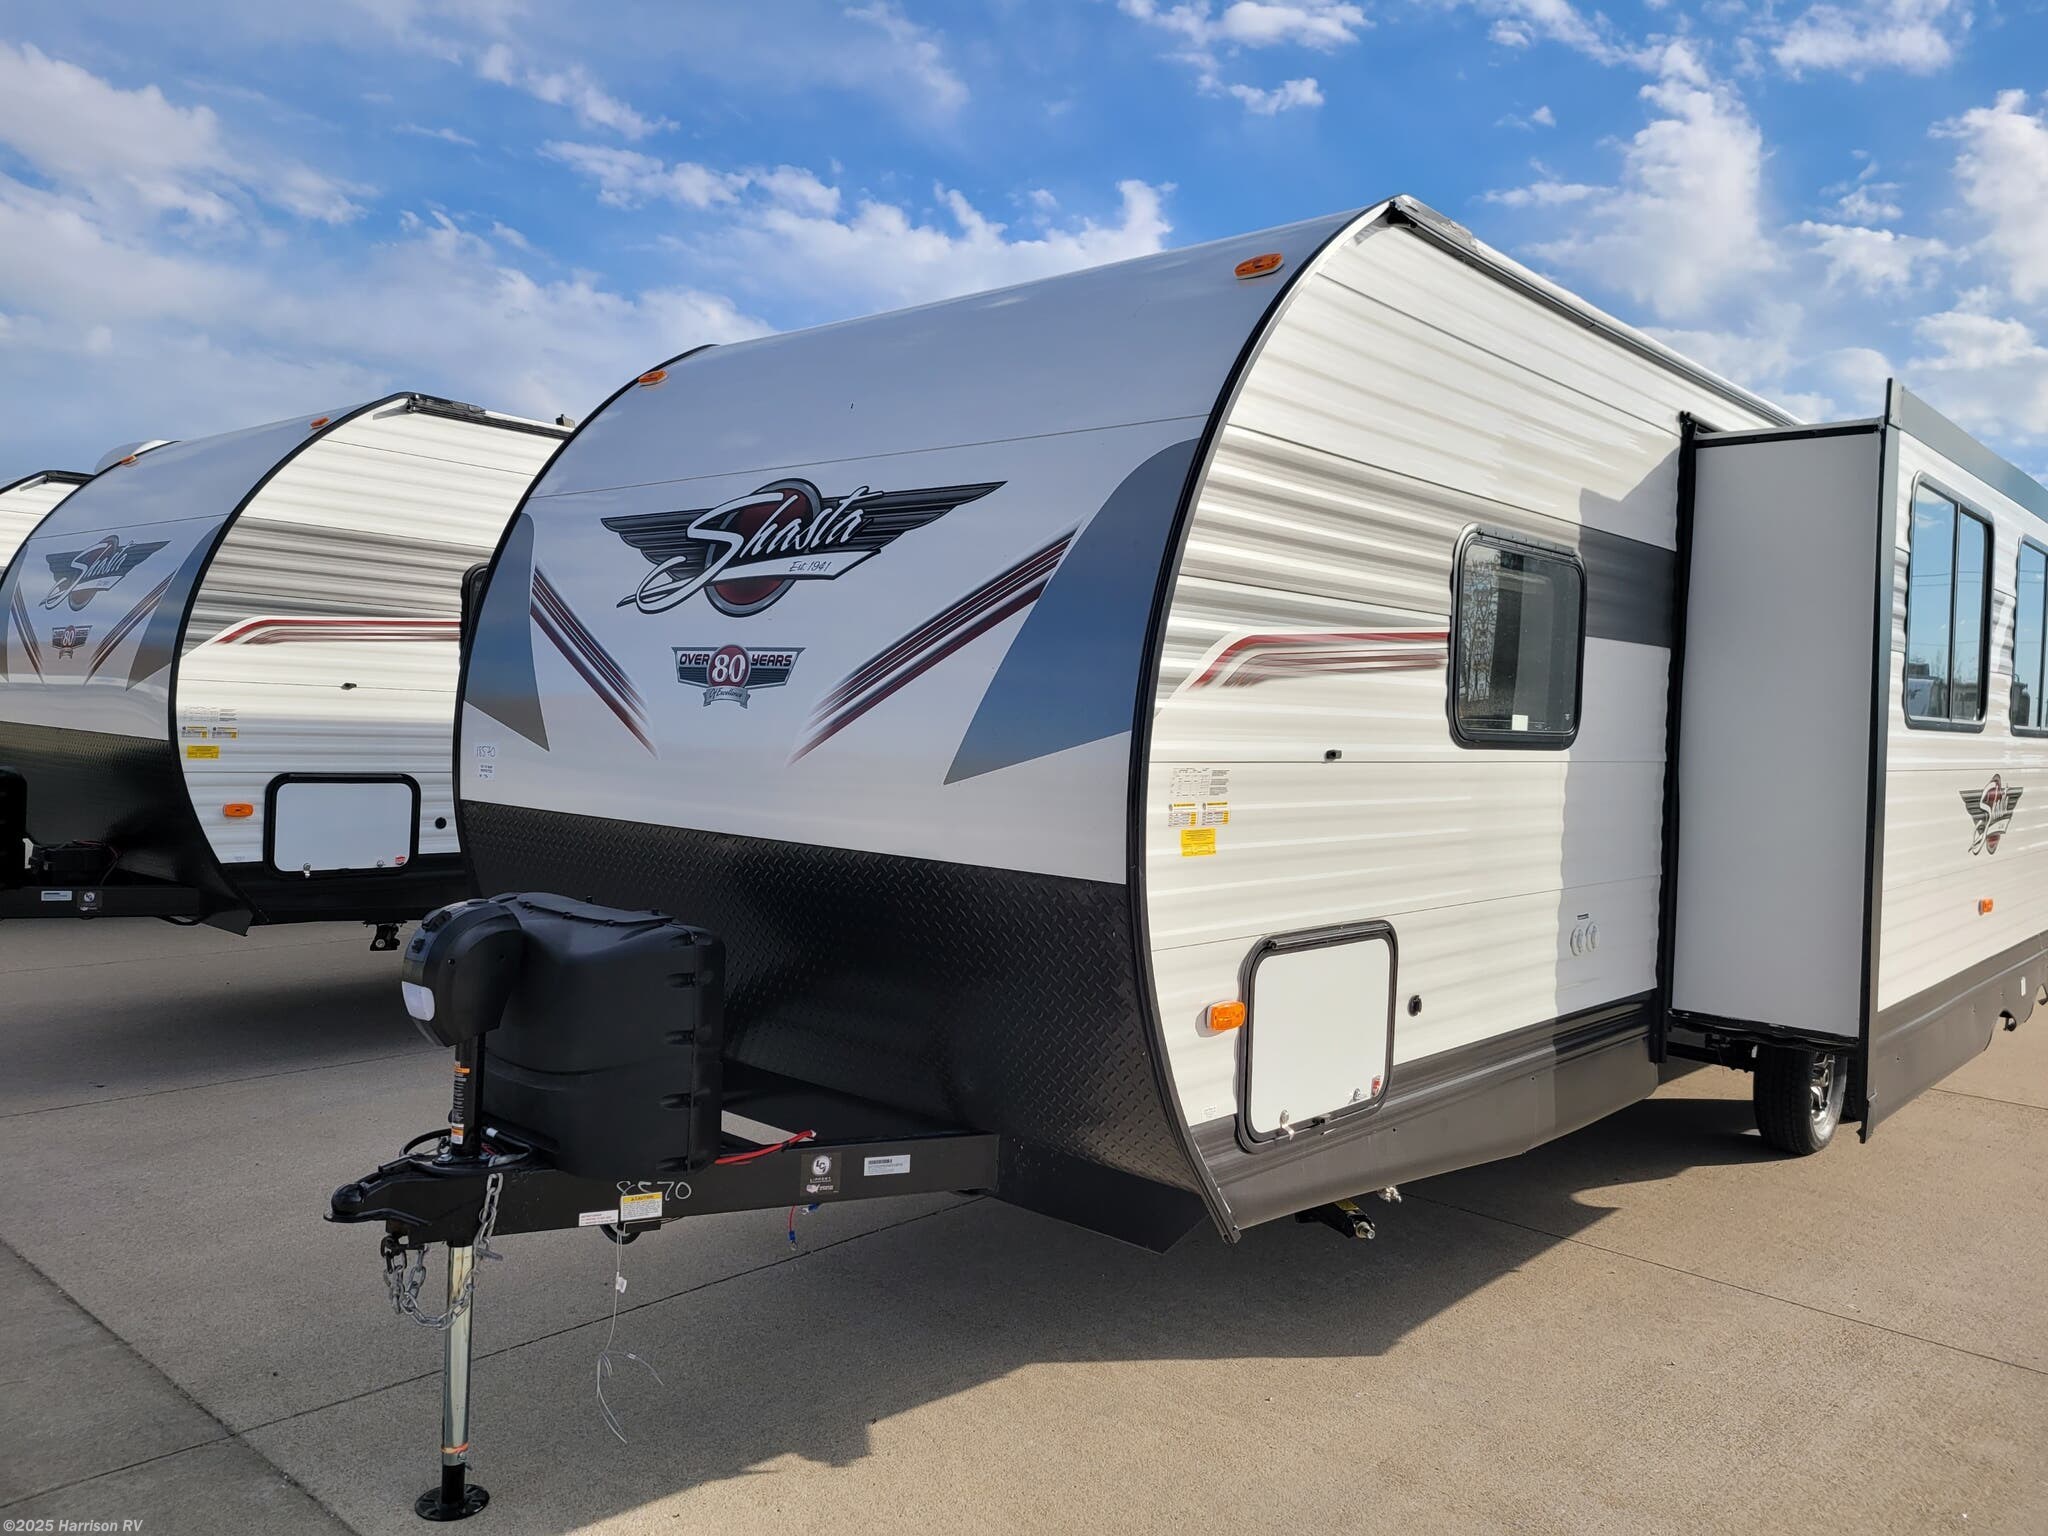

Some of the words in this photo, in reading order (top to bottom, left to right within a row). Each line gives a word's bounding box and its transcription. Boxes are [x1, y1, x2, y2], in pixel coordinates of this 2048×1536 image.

[635, 484, 885, 615] Shasta
[807, 559, 833, 573] 1941
[62, 629, 75, 646] 80
[679, 653, 710, 666] OVER
[711, 653, 746, 683] 80
[750, 653, 794, 668] YEARS
